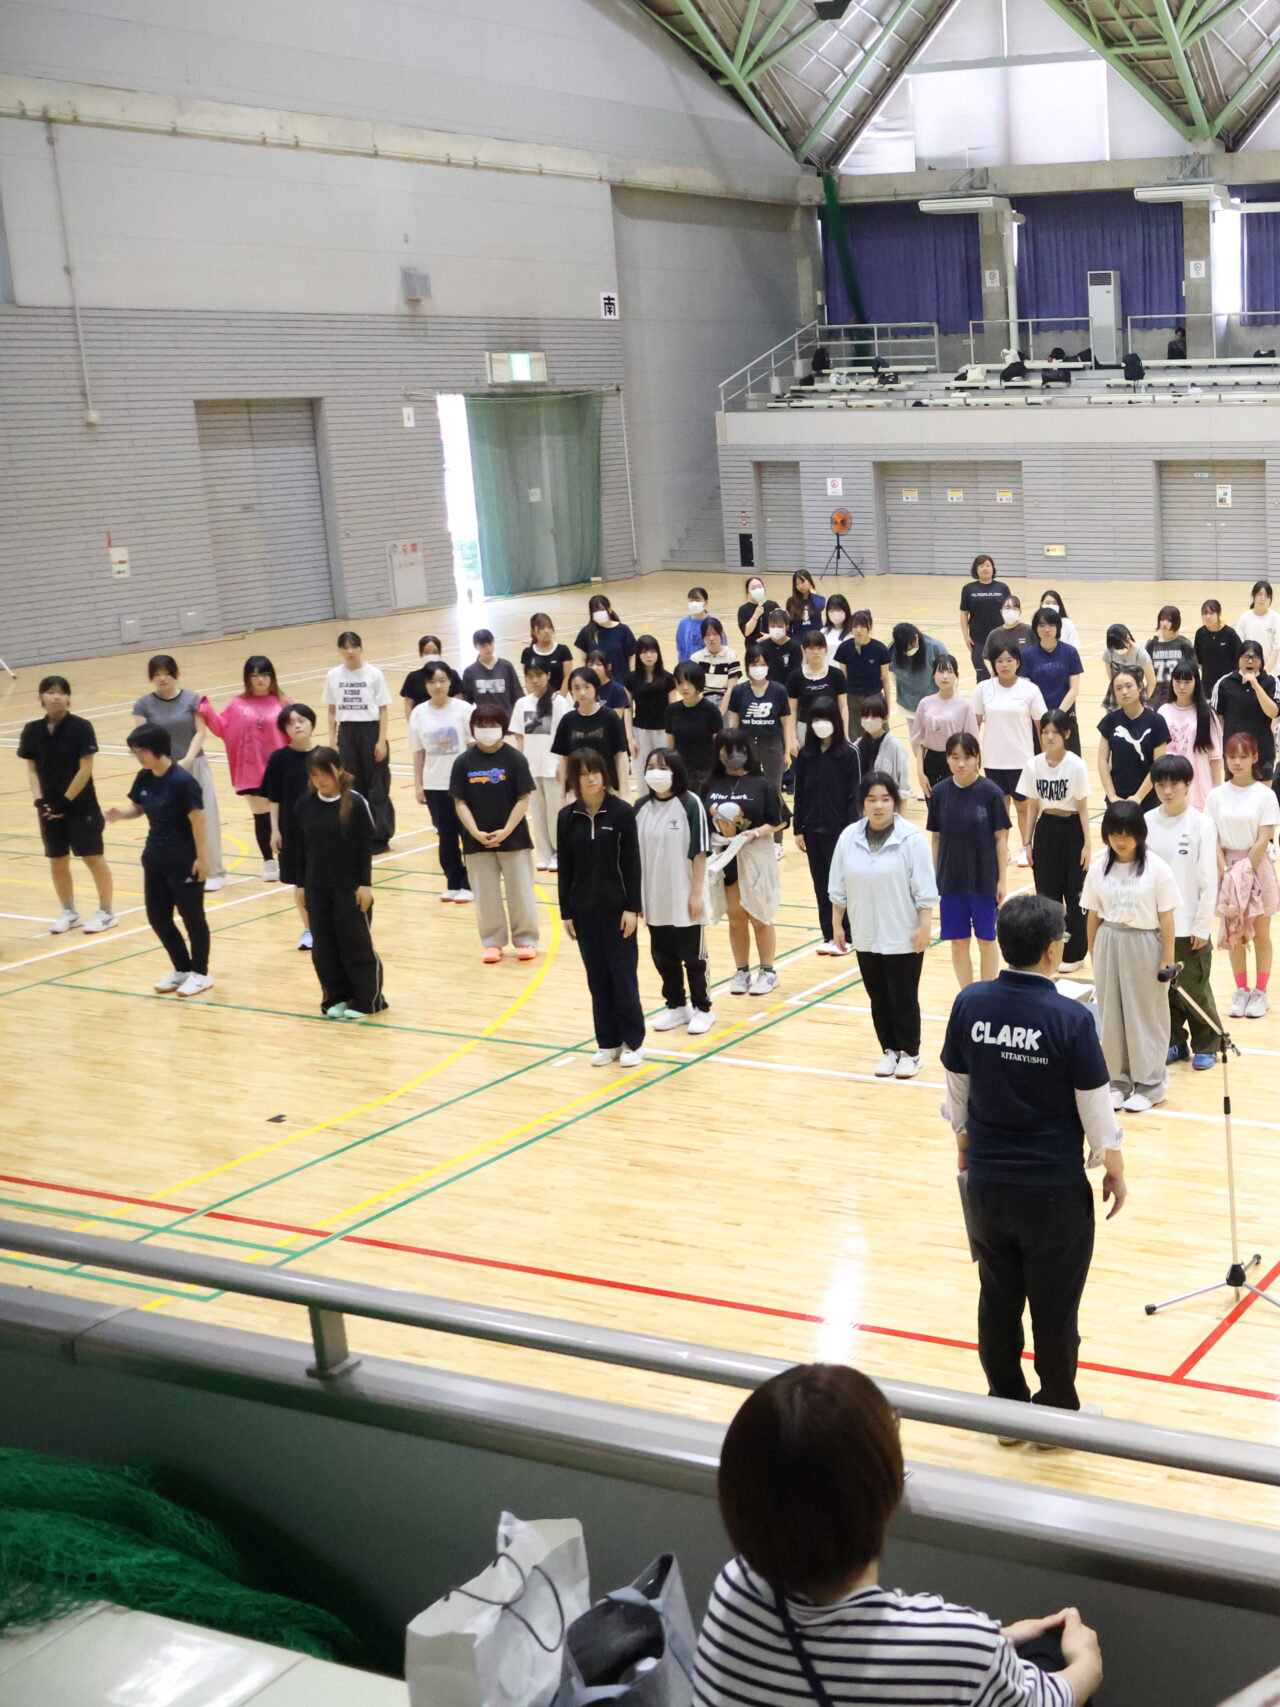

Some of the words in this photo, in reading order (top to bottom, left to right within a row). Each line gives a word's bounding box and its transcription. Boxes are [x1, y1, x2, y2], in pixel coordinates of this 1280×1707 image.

[602, 294, 616, 317] 南
[710, 792, 729, 801] After
[970, 1020, 1043, 1052] CLARK
[1000, 1051, 1050, 1066] KITAKYUSHU
